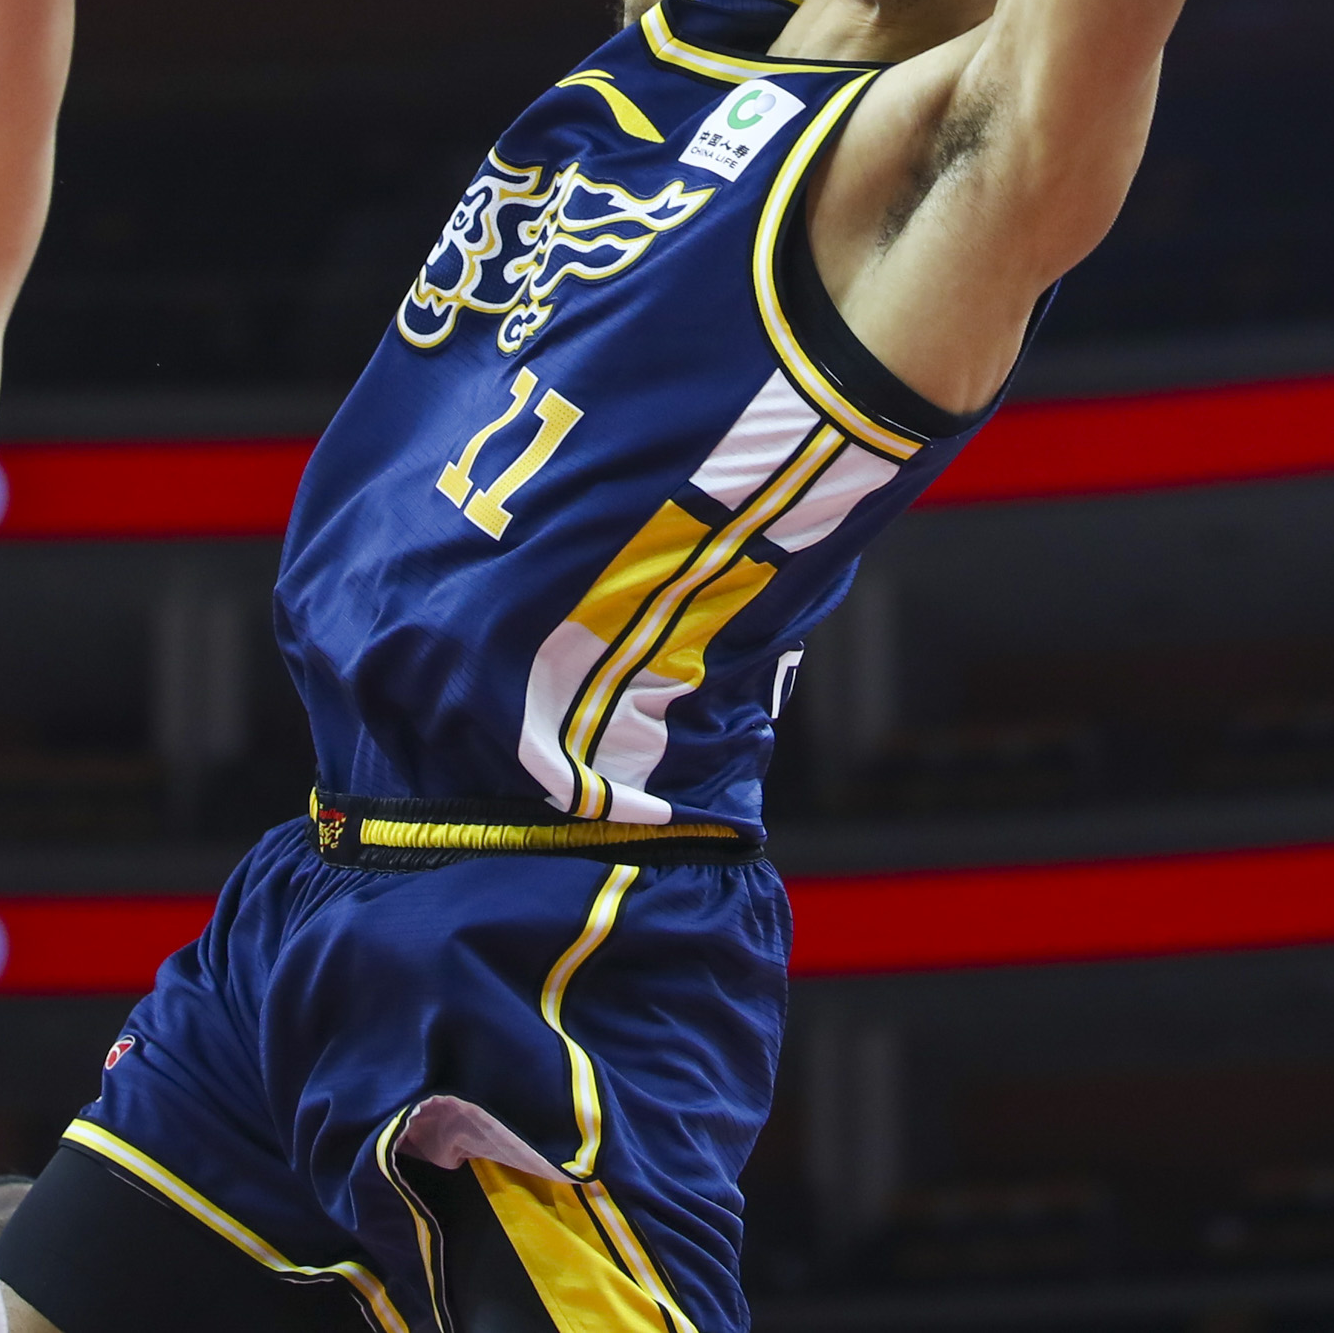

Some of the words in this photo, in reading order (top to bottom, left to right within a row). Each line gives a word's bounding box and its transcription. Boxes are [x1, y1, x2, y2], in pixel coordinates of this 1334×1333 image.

[690, 146, 714, 158] CHINA
[715, 154, 739, 169] LIFE
[699, 130, 750, 158] 中国人寿
[435, 367, 584, 541] 11
